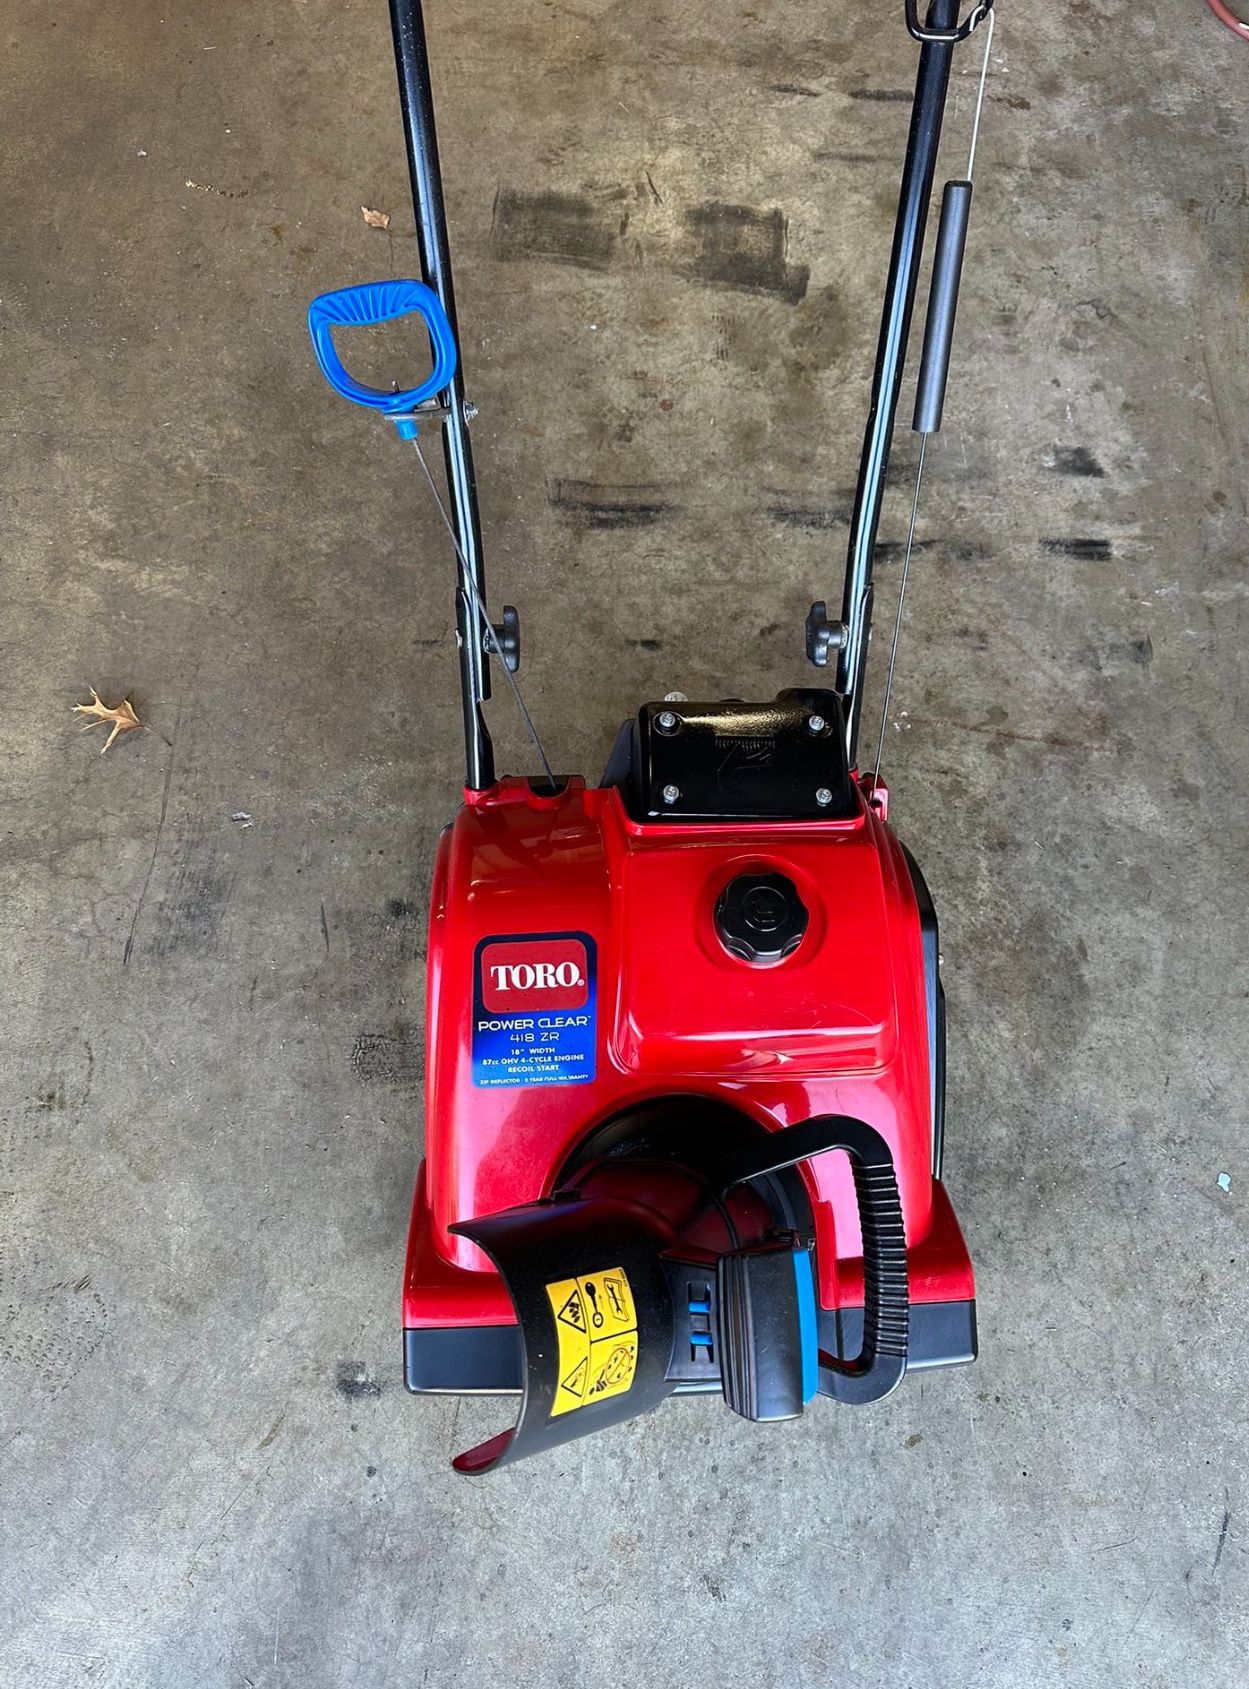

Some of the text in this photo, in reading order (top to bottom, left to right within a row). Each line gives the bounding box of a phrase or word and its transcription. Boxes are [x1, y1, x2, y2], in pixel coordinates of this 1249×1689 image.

[491, 962, 581, 991] TORO
[478, 1015, 589, 1031] POWER CLEAR
[510, 1032, 560, 1042] 418 ZR
